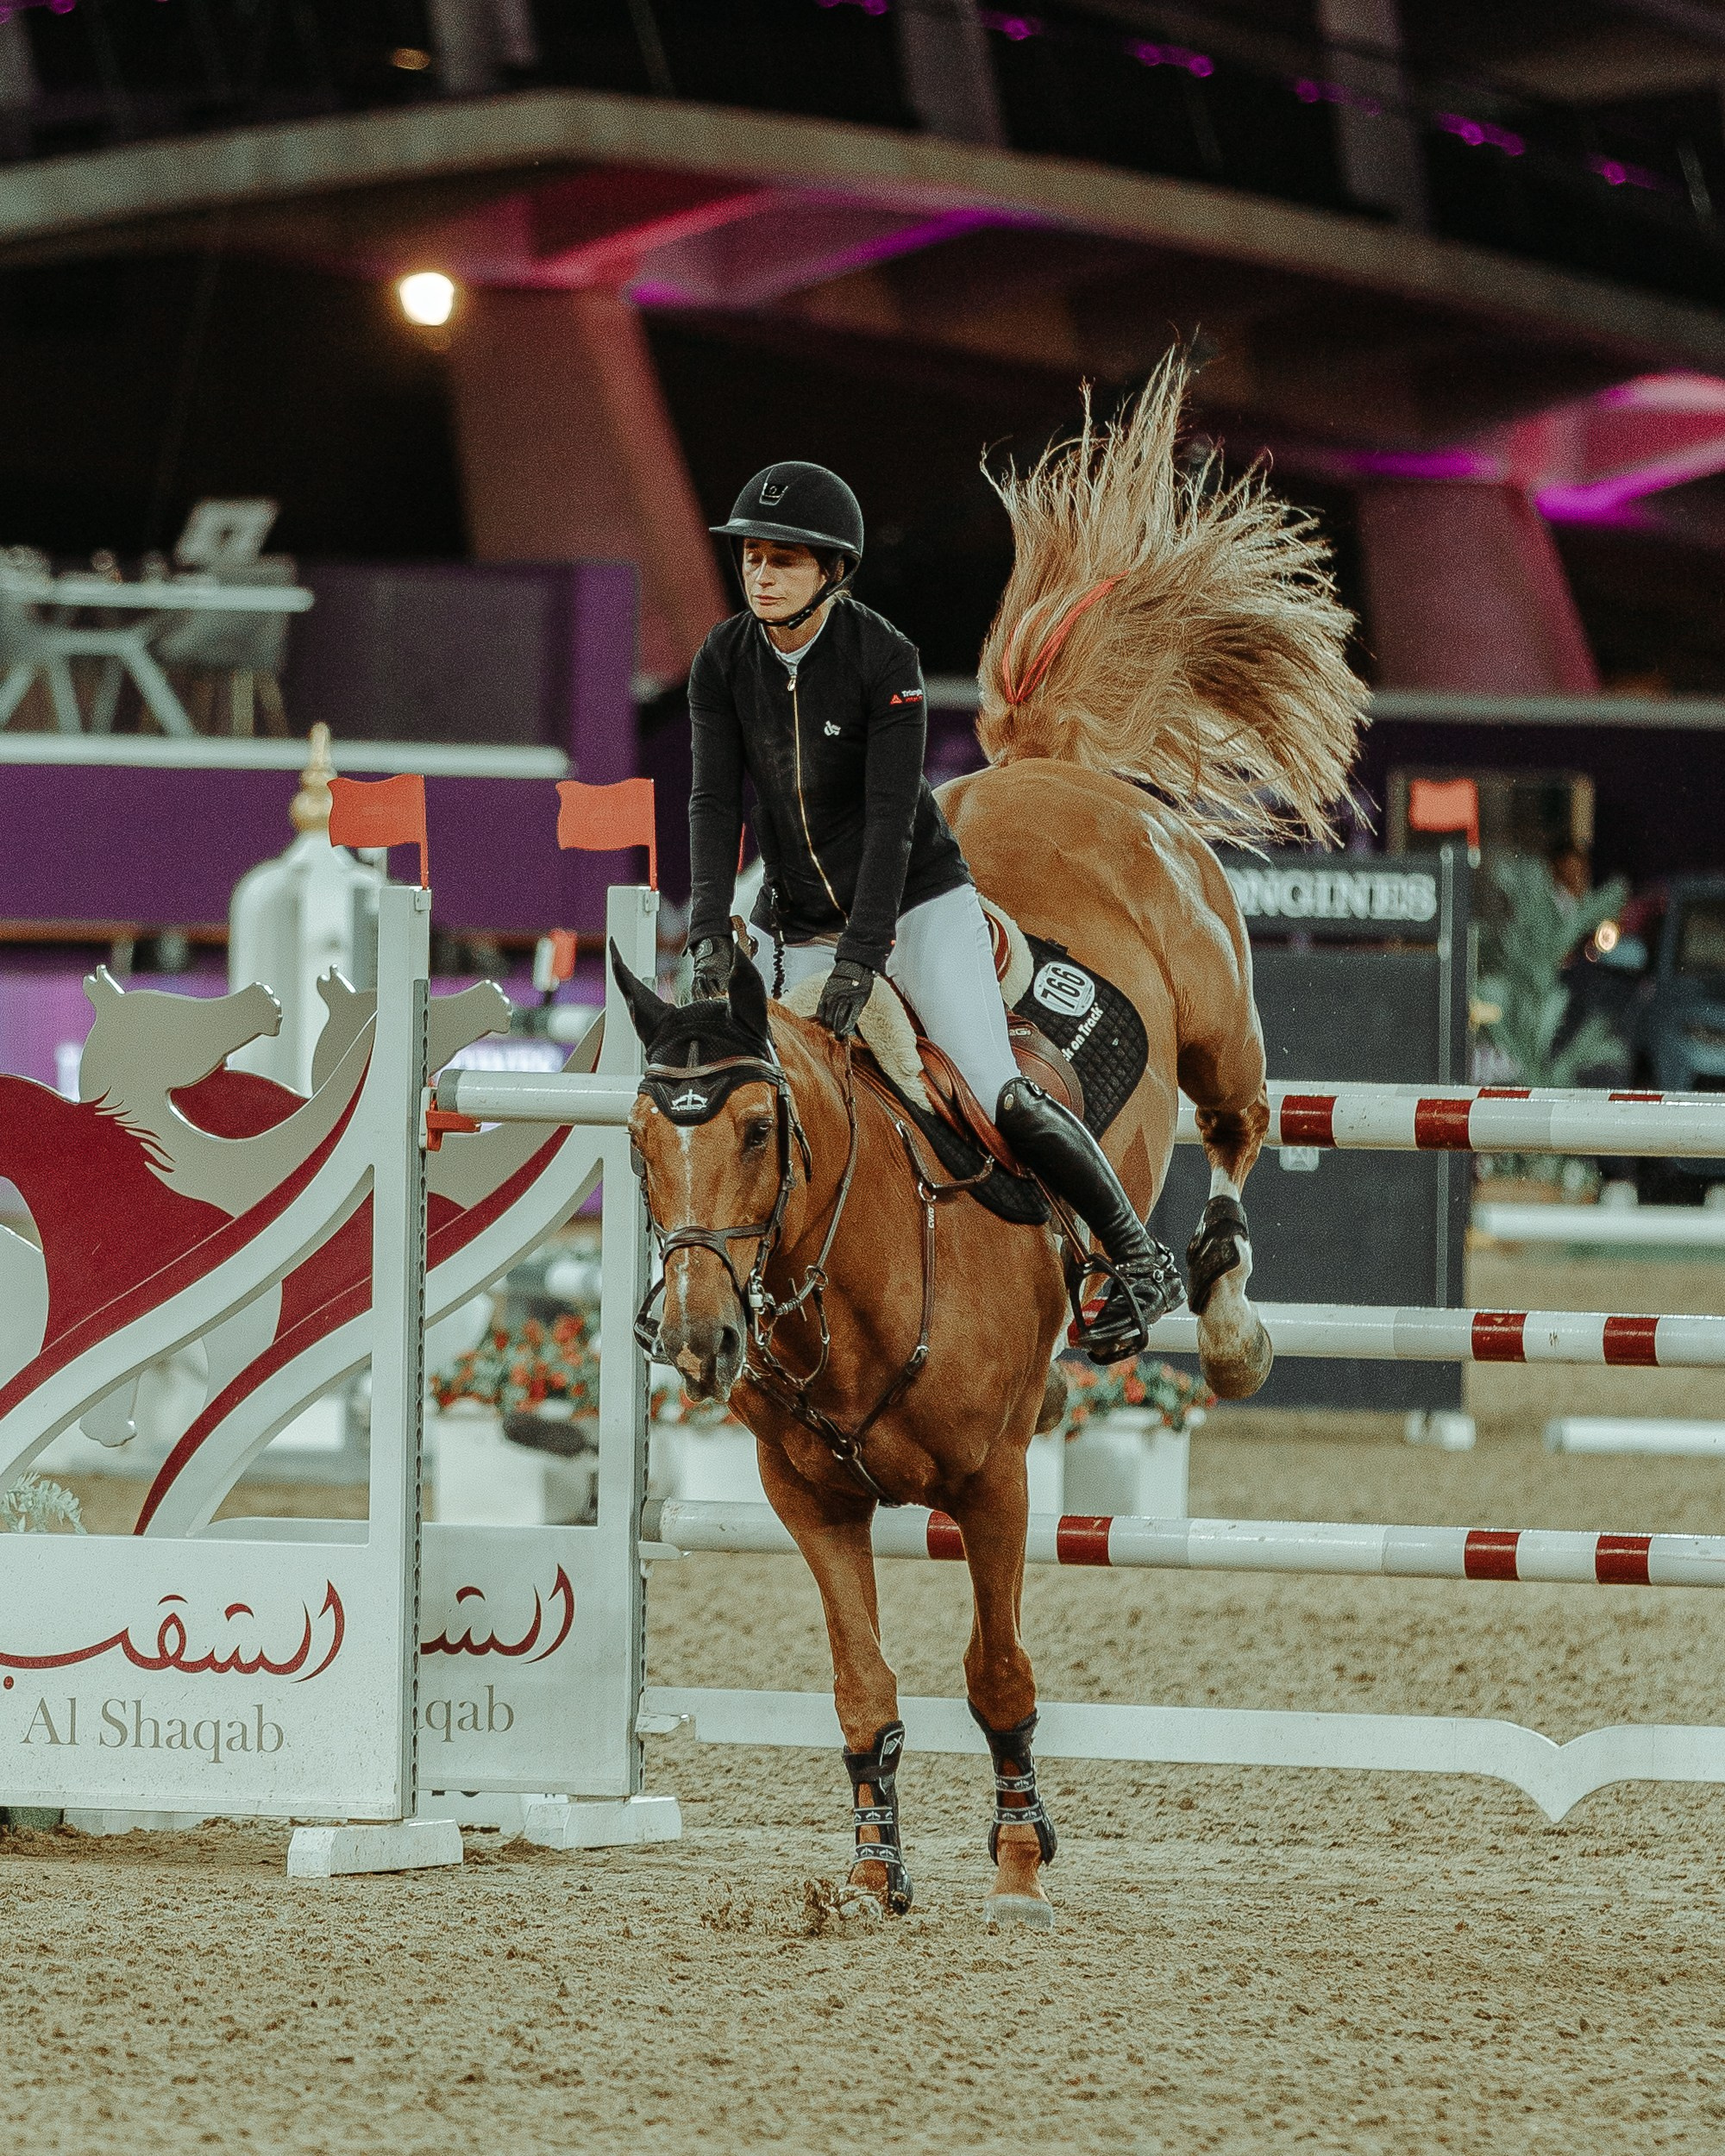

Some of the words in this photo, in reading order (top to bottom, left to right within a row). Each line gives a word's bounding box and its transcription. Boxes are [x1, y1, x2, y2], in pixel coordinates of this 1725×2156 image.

[1225, 868, 1437, 921] NGINES
[1040, 967, 1086, 1010] 766
[1070, 1034, 1086, 1050] on
[420, 1563, 575, 1665] الش
[19, 1696, 80, 1745] Al
[98, 1698, 285, 1764] Shaqab
[419, 1684, 515, 1743] qab
